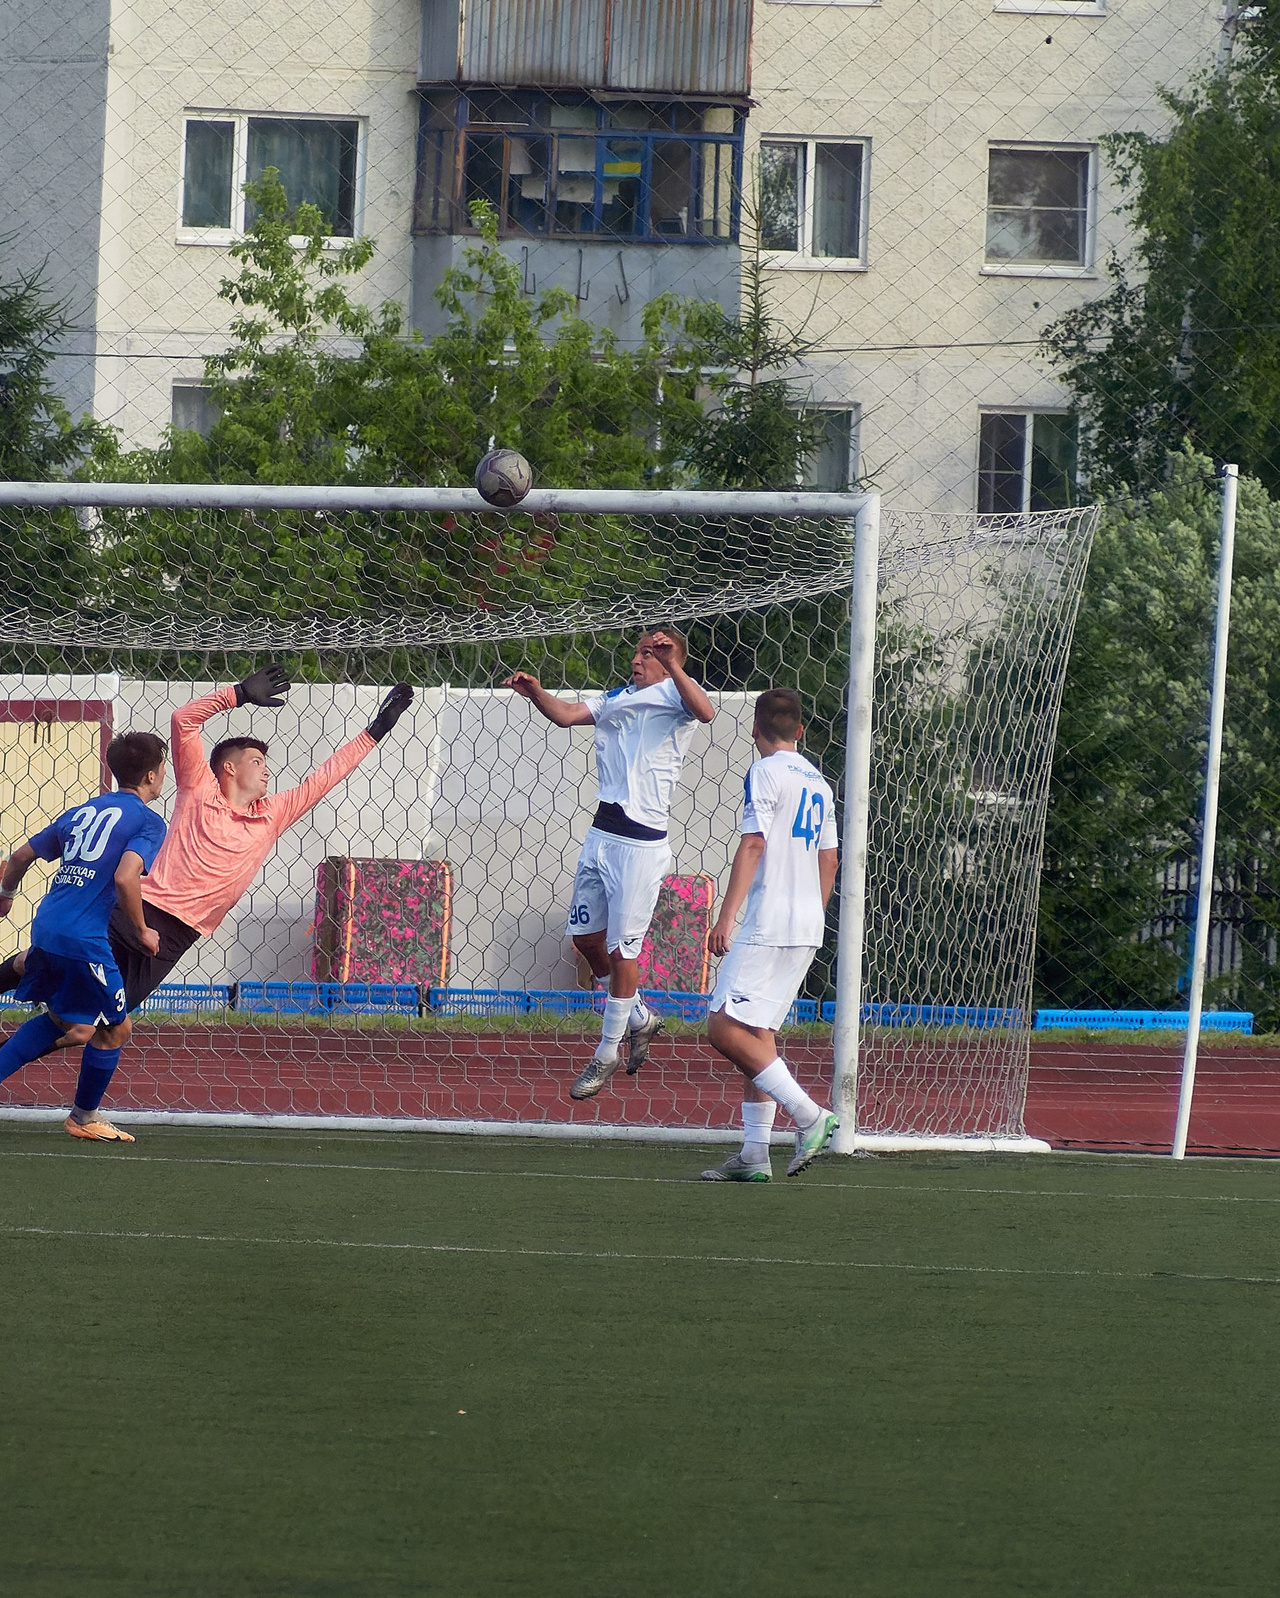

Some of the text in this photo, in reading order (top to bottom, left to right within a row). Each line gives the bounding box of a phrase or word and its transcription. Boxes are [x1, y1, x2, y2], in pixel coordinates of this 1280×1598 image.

[63, 805, 123, 862] 30
[569, 904, 590, 925] 96
[114, 987, 126, 1012] 3
